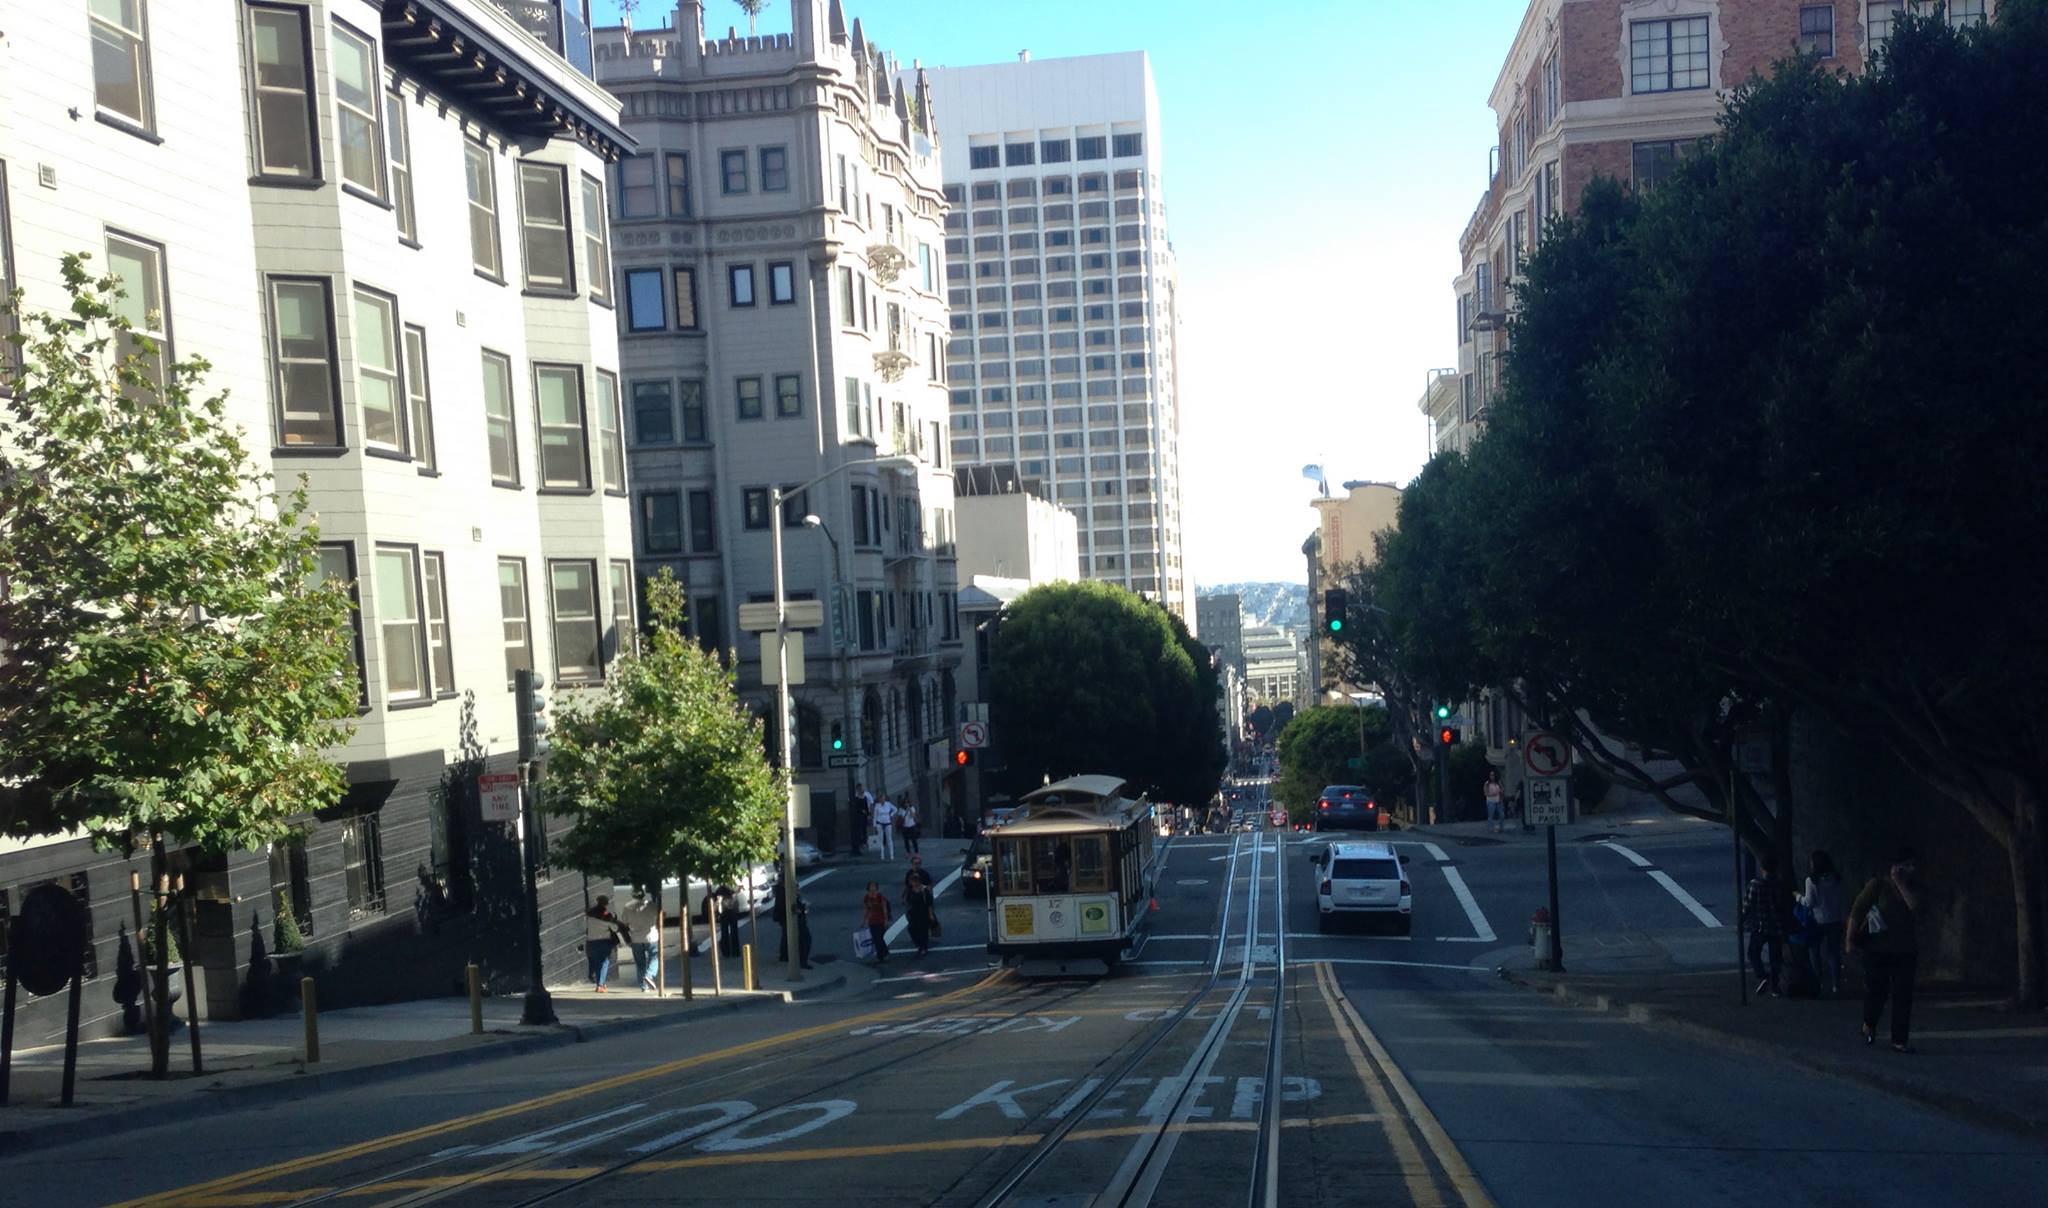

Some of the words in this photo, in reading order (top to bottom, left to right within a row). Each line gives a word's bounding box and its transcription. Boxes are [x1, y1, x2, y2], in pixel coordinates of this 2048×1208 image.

[1533, 806, 1544, 814] DO
[1548, 806, 1564, 814] NOT
[1538, 815, 1560, 823] PASS
[1049, 899, 1064, 909] 17
[936, 1076, 1322, 1120] KEEP
